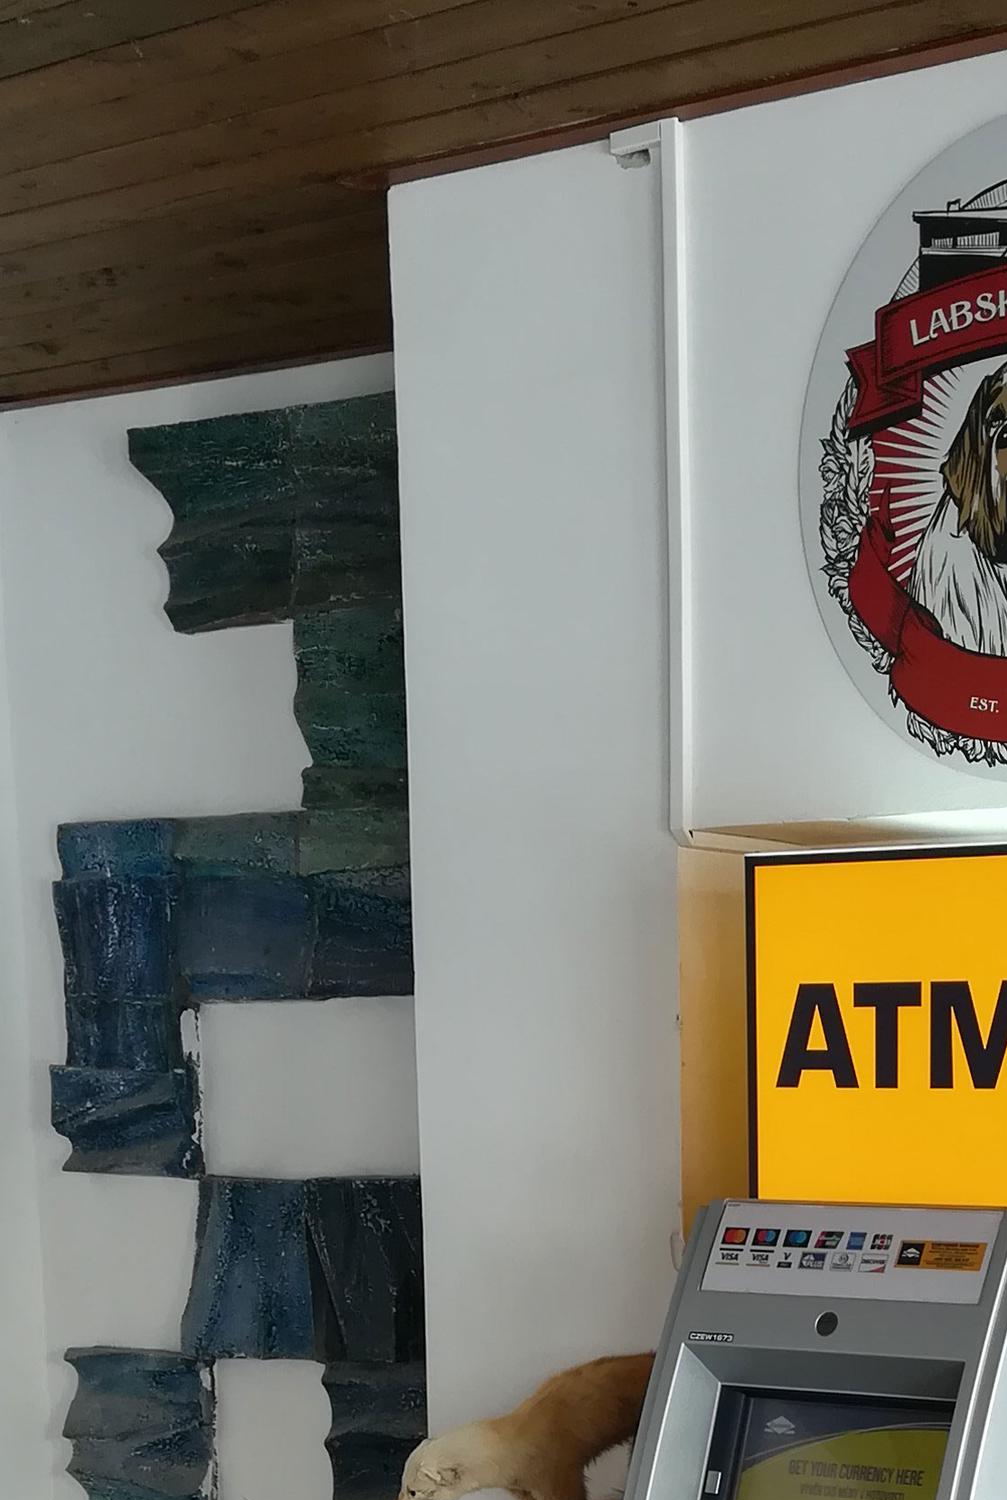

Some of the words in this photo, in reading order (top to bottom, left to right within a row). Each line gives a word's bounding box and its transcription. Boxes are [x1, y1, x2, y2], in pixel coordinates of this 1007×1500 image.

[969, 696, 999, 714] EST.
[721, 1252, 739, 1261] VISA
[752, 1253, 769, 1261] VISA
[788, 1459, 808, 1475] GET
[811, 1461, 838, 1479] YOUR
[839, 1463, 895, 1484] CURRENCY
[895, 1468, 924, 1487] HERE
